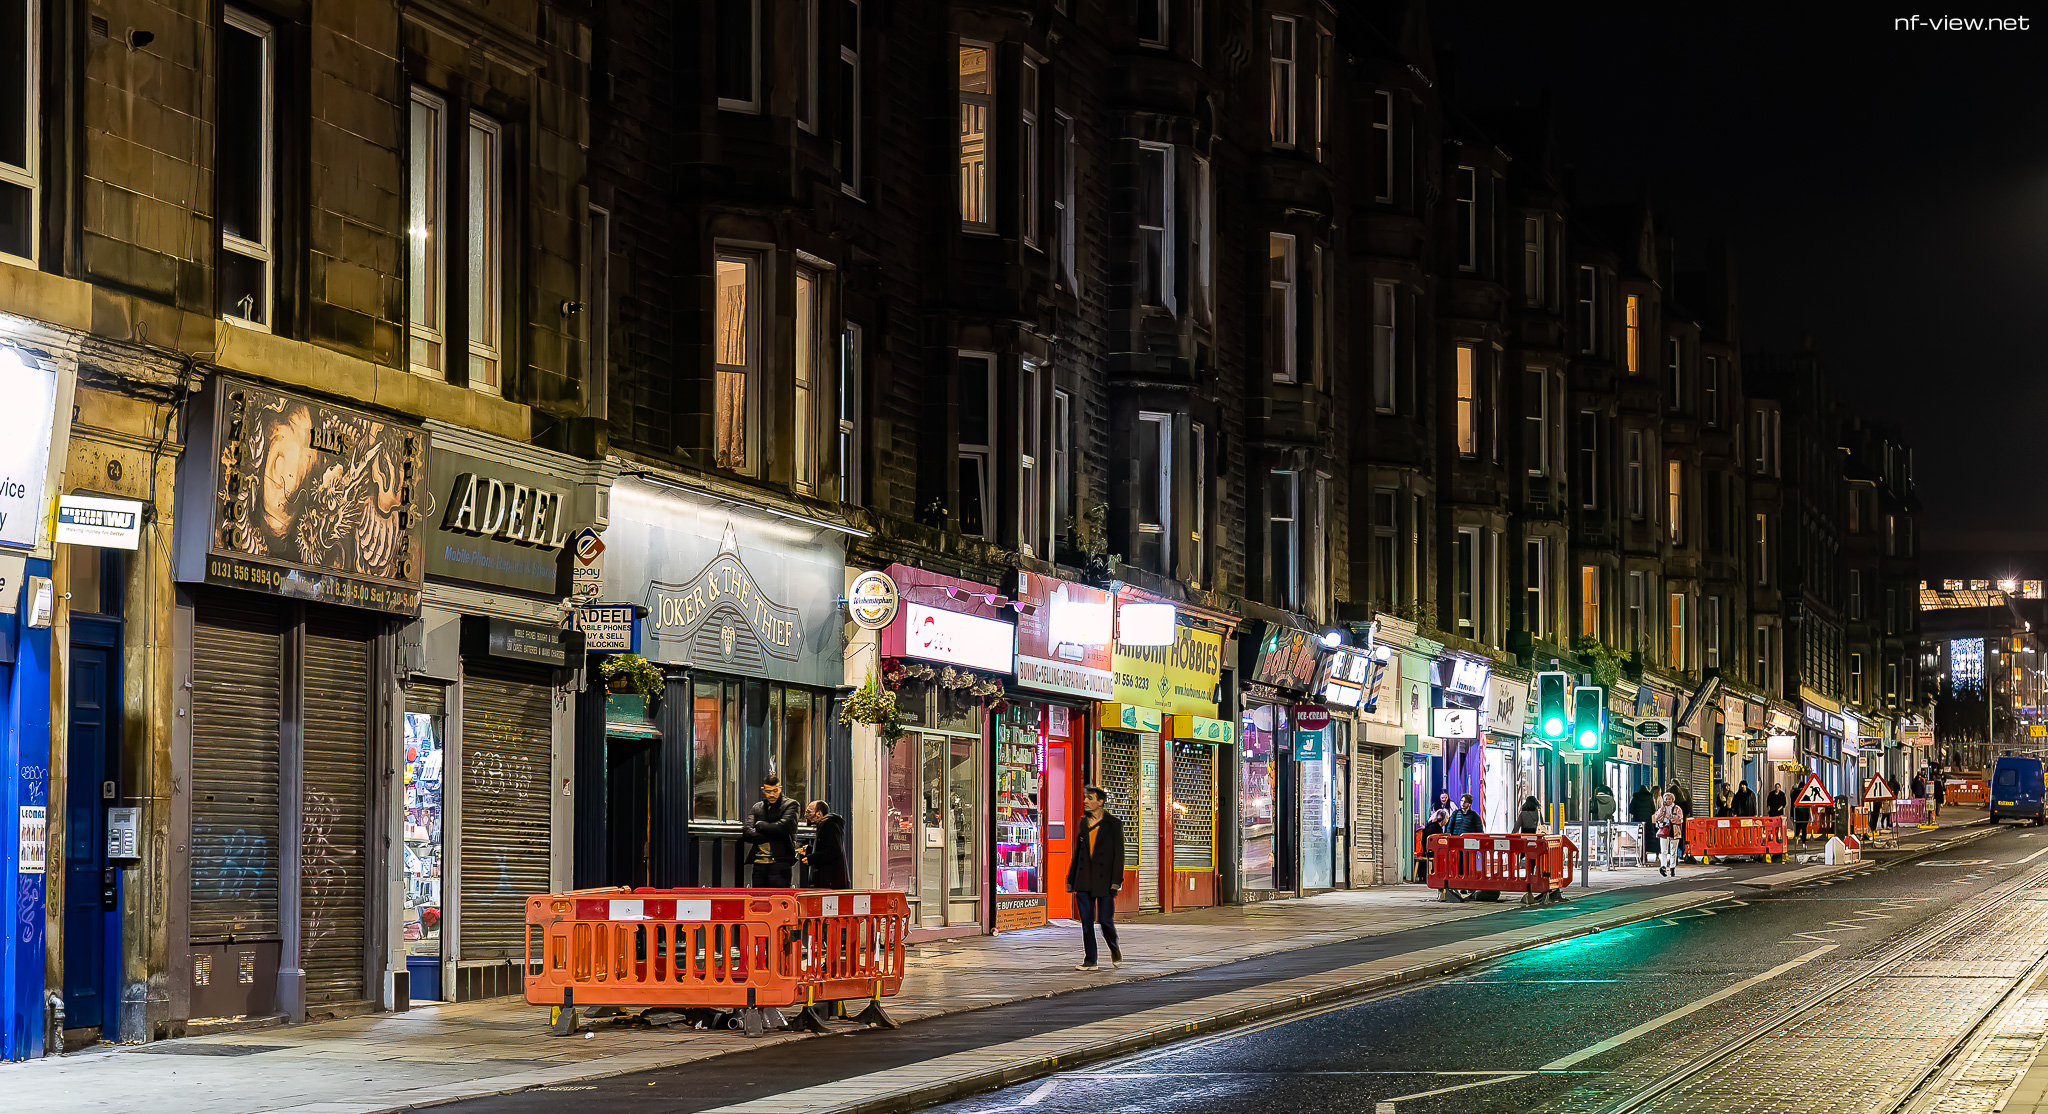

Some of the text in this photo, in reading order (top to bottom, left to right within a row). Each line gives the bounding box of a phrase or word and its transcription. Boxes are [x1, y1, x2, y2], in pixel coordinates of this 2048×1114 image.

[313, 428, 351, 451] BILL'S
[109, 463, 120, 477] 74
[61, 507, 103, 519] WESTERN
[454, 473, 567, 549] ADEEL
[73, 515, 103, 526] UNION
[445, 545, 470, 563] Mobile
[471, 551, 495, 568] Phone
[496, 555, 524, 573] Repairs
[211, 561, 231, 579] 0131
[234, 565, 249, 582] 556
[251, 568, 271, 585] 5954
[573, 567, 600, 579] epay
[655, 566, 793, 647] JOKER & THE THIEF
[581, 610, 631, 623] ADEEL
[587, 632, 624, 640] UY & SELL
[1171, 635, 1218, 676] HOBBIES
[1020, 661, 1113, 695] BUYING SELLING REPAIRING UNLOCKING
[1122, 674, 1133, 688] 556
[1134, 675, 1149, 690] 3233
[1002, 901, 1013, 910] BUY
[1013, 900, 1024, 909] FOR
[1024, 898, 1039, 908] CASH
